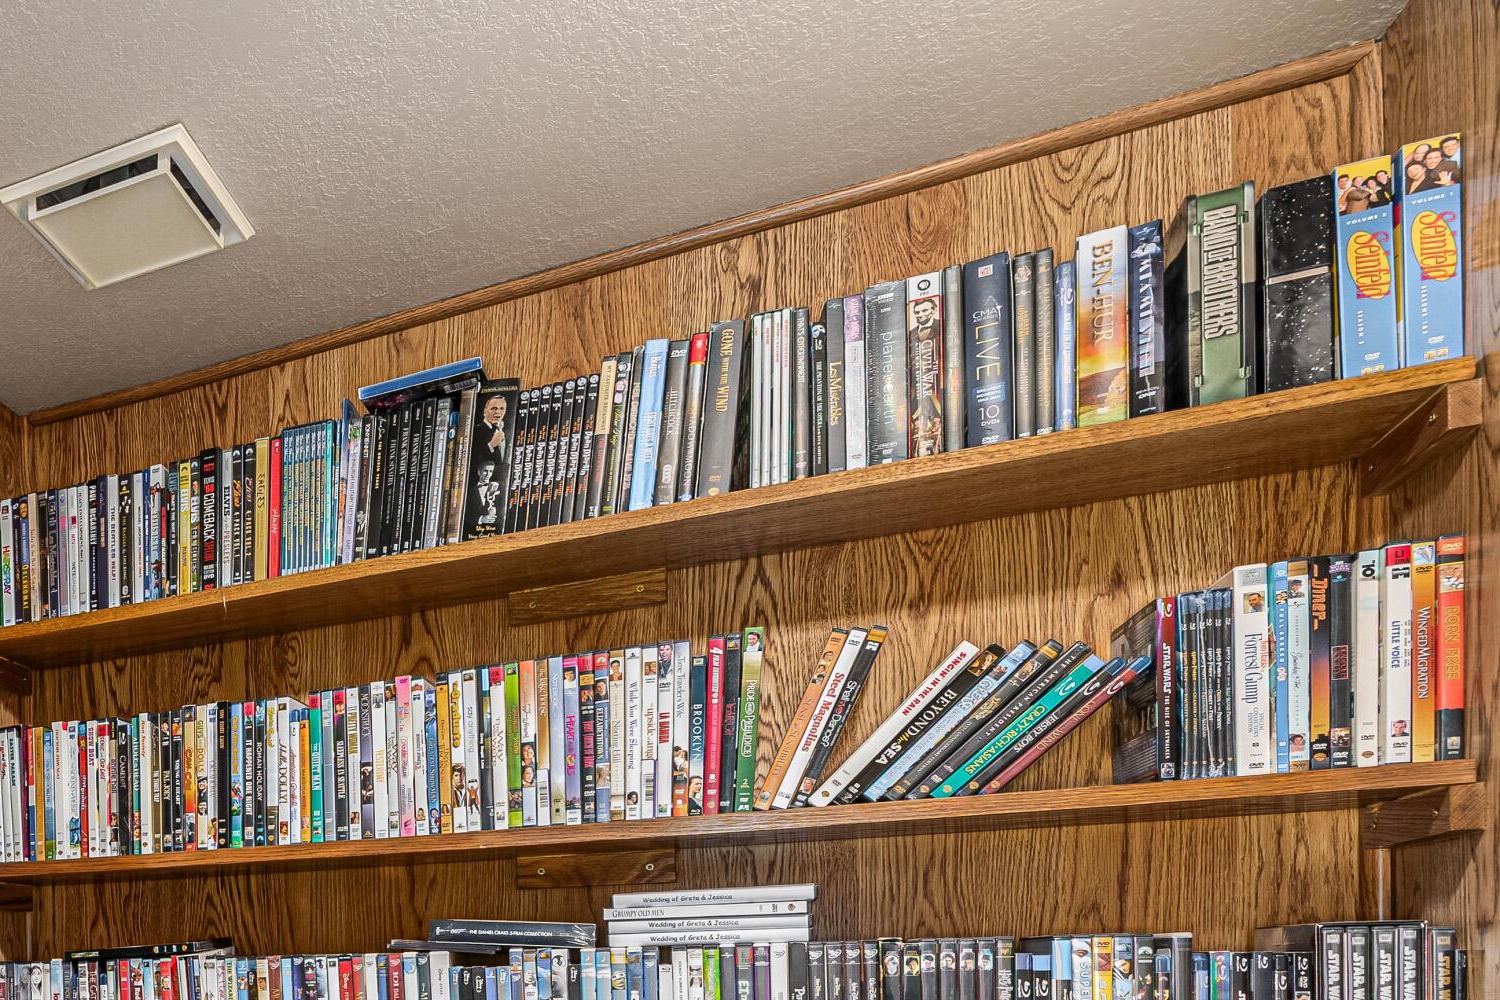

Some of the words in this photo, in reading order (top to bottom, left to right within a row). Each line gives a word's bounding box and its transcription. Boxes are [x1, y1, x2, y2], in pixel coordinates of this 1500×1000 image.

[1204, 204, 1238, 245] BAND
[1418, 211, 1457, 281] Seinfeld
[1354, 231, 1391, 300] Seinfeld
[1091, 240, 1114, 347] BEN-HUR
[1204, 261, 1238, 340] BROTHERS
[975, 322, 1000, 382] LIVE
[204, 493, 214, 541] COMEBACK
[1444, 606, 1460, 641] BORN
[1244, 633, 1262, 667] Forrest
[1444, 645, 1460, 680] FREE
[828, 673, 844, 702] Steel
[1244, 668, 1262, 704] Gump
[692, 704, 702, 761] BROOKLYN
[802, 701, 833, 752] Magnolias
[907, 690, 957, 737] BEYOND
[875, 740, 902, 765] SEA
[1327, 950, 1340, 984] STAR
